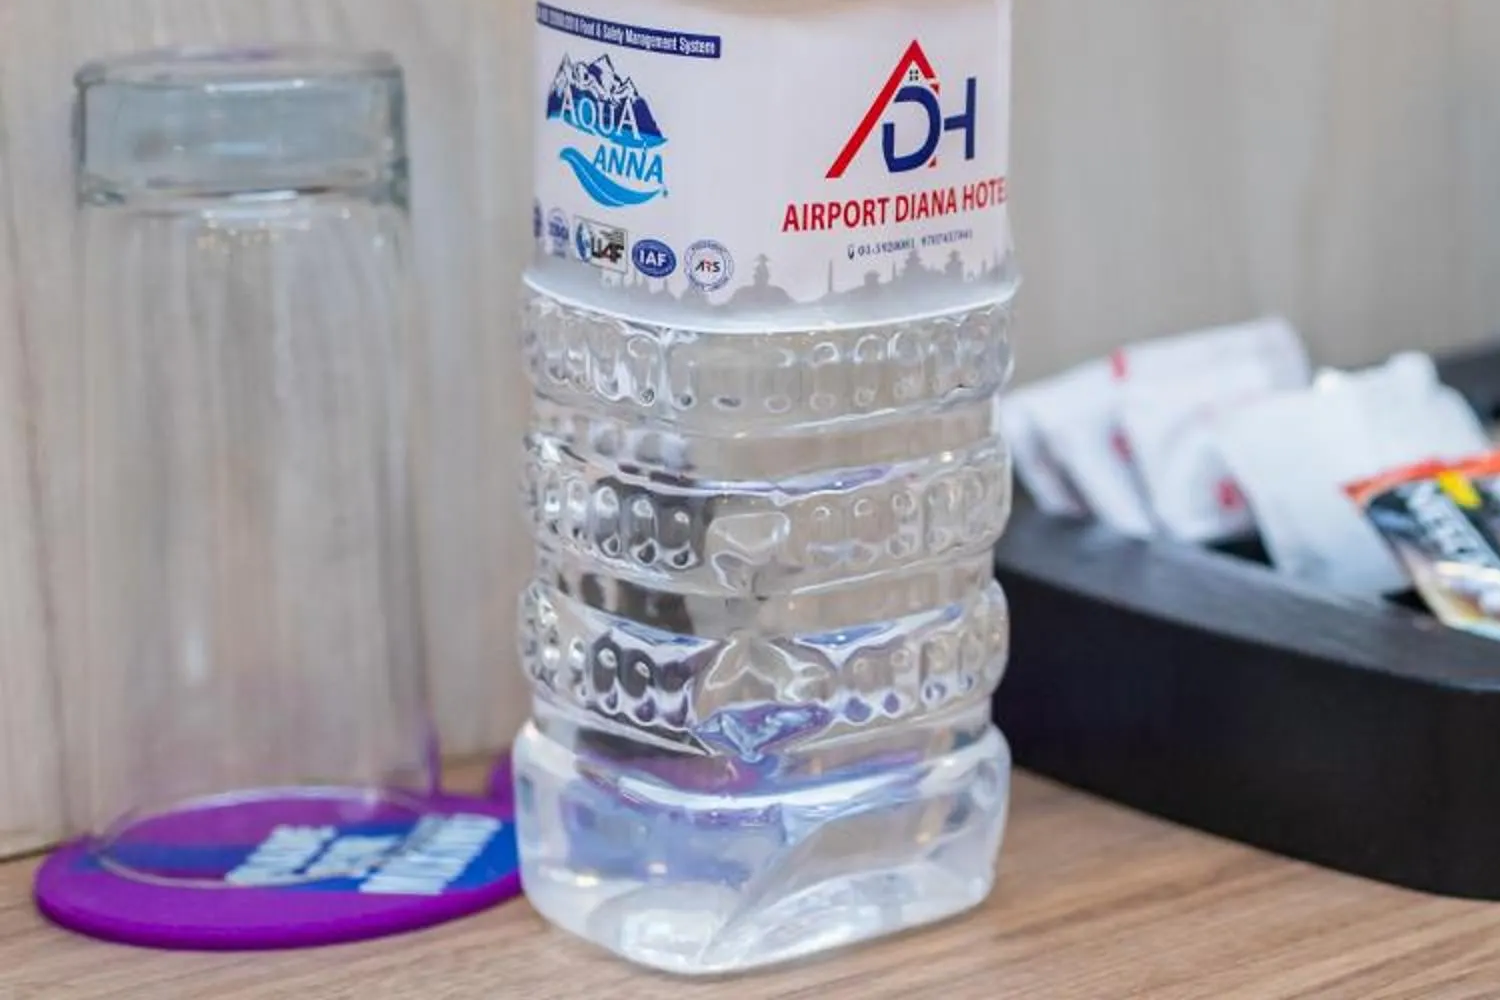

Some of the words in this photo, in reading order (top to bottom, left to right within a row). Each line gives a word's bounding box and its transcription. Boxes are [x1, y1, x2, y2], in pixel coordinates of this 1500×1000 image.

[625, 28, 677, 52] Management
[679, 36, 716, 55] System
[560, 84, 644, 141] AQUA
[593, 143, 663, 185] ANNA
[782, 197, 891, 233] AIRPORT
[895, 185, 958, 223] DIANA
[961, 177, 1007, 212] HOTE
[639, 250, 667, 267] IAF
